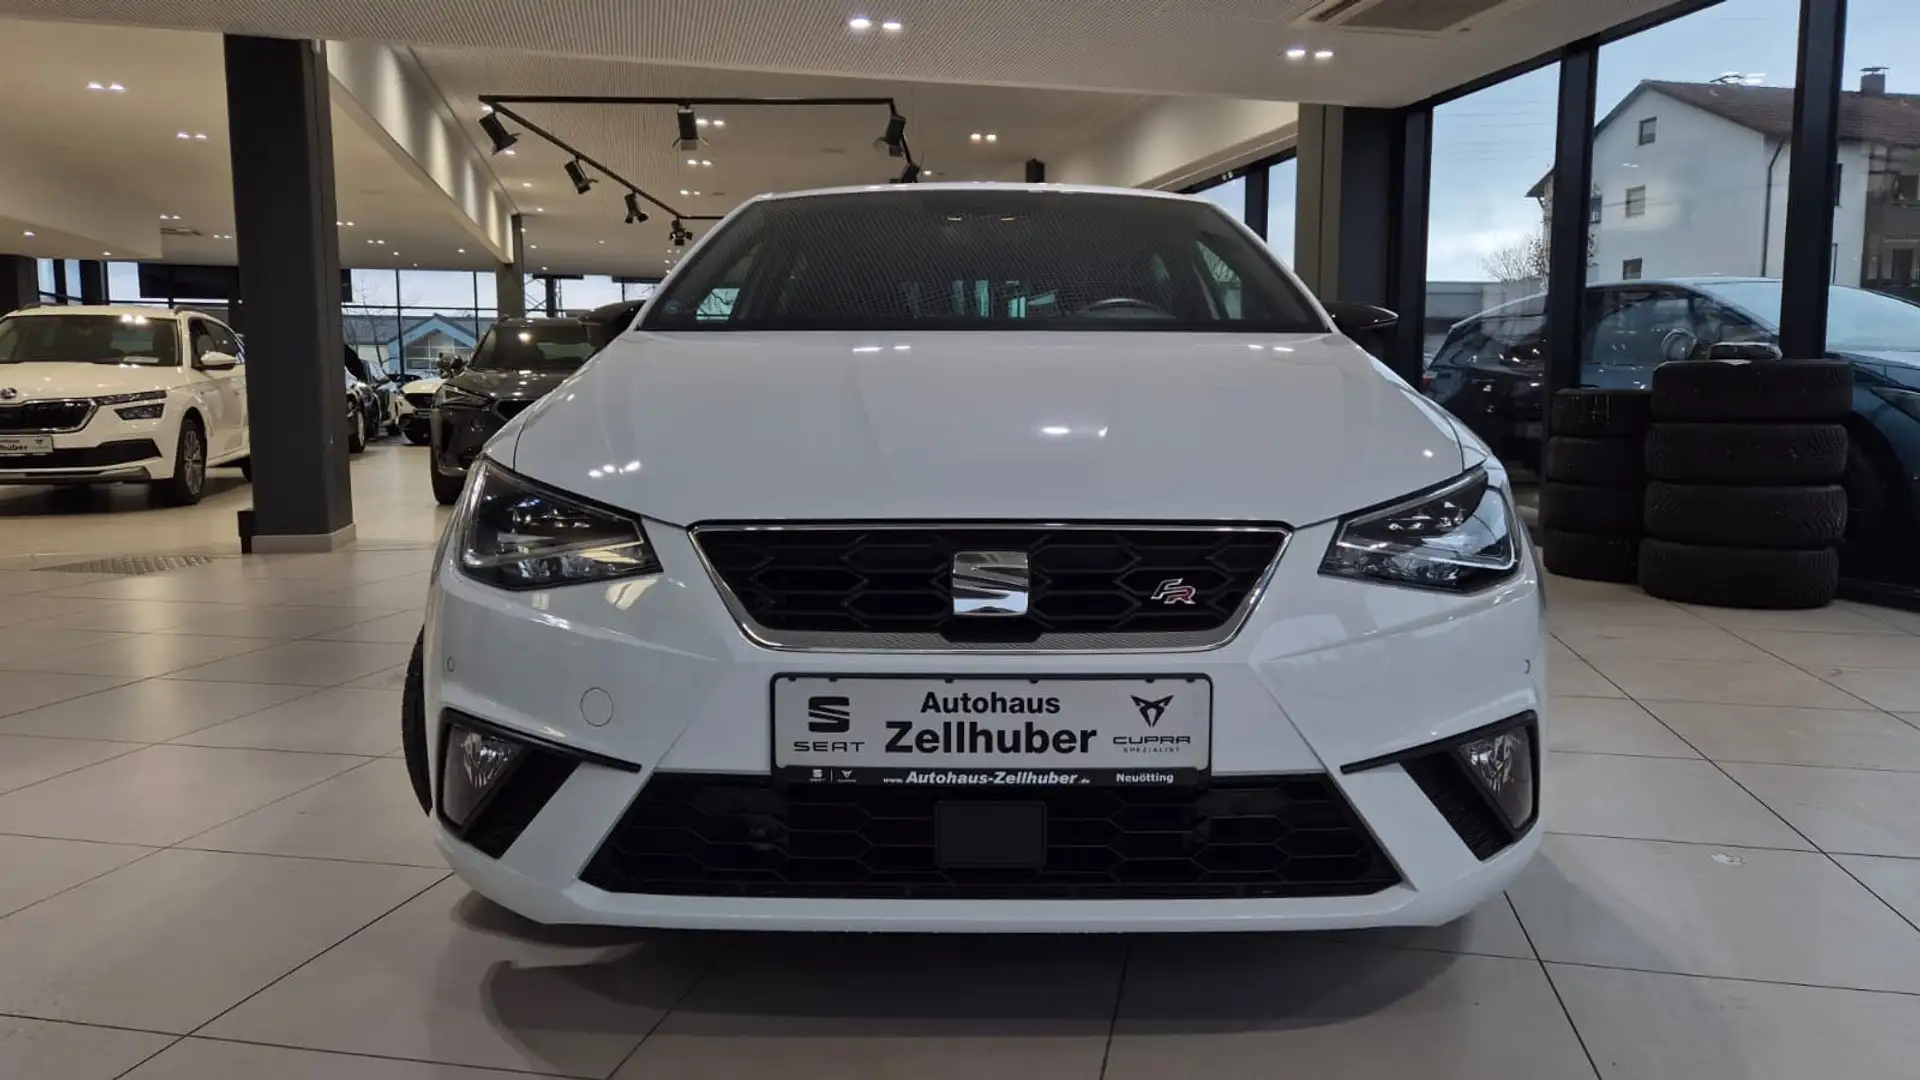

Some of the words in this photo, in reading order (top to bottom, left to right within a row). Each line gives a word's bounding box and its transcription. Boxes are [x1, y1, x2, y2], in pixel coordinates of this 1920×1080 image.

[1151, 578, 1195, 604] FR
[920, 691, 1060, 714] Autohaus
[885, 721, 1097, 753] Zellhuber
[1112, 736, 1190, 745] CUPRA
[794, 741, 865, 752] SEAT
[1116, 772, 1174, 784] Neuötting
